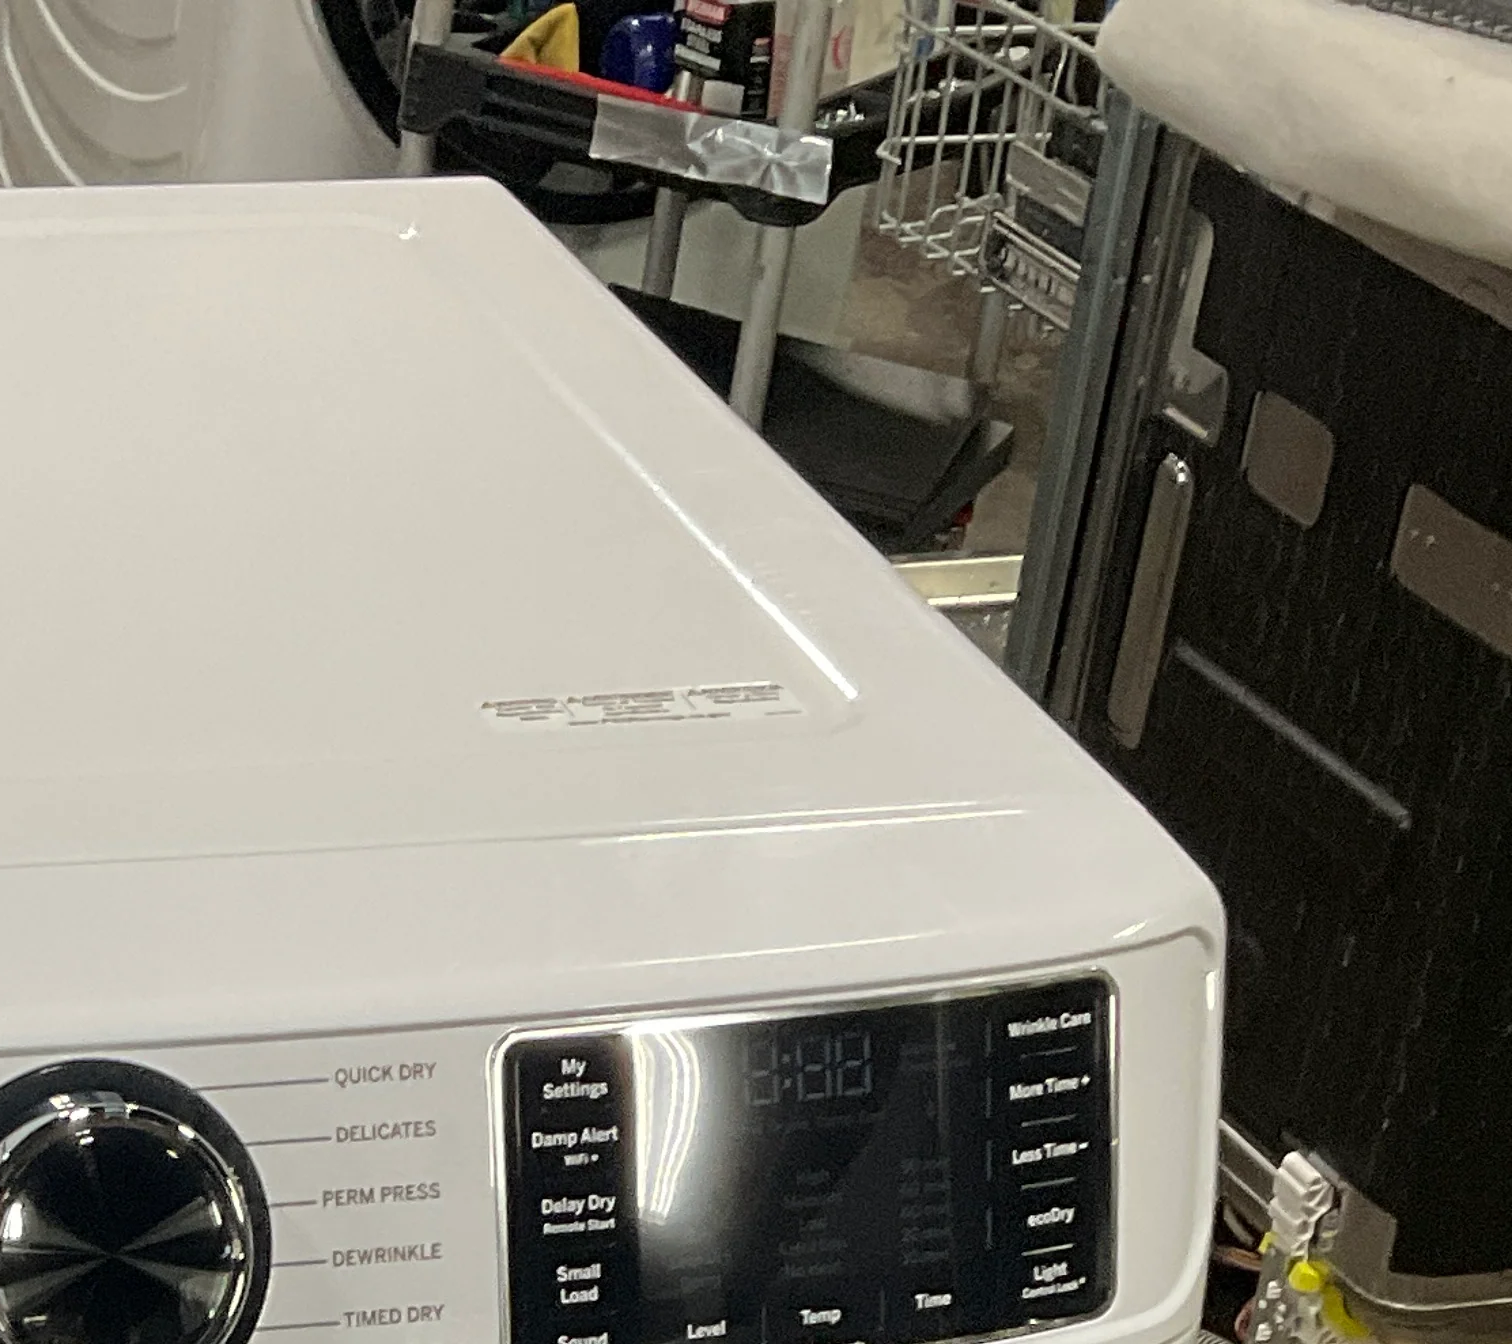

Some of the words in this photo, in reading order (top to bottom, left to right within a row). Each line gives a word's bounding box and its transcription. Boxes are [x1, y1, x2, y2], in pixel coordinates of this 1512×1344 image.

[1008, 1017, 1058, 1037] Wrinkle
[1060, 1013, 1091, 1028] Care
[335, 1066, 393, 1089] QUICK
[399, 1063, 436, 1081] DRY
[562, 1059, 586, 1077] My
[543, 1082, 608, 1099] Settings
[1010, 1084, 1043, 1100] More
[1045, 1078, 1079, 1093] Time
[336, 1120, 436, 1143] DELICATES
[532, 1132, 577, 1148] Damp
[581, 1126, 618, 1143] Alert
[1012, 1149, 1042, 1164] Less
[1043, 1142, 1077, 1158] Time
[323, 1188, 376, 1207] PERM
[380, 1183, 440, 1202] PRESS
[541, 1198, 585, 1215] Delay
[588, 1195, 616, 1212] Dry
[1028, 1207, 1074, 1226] ecoDry
[333, 1243, 441, 1267] DEWRINKLE
[556, 1264, 601, 1282] Small
[1034, 1262, 1067, 1282] Light
[560, 1286, 598, 1304] Load
[915, 1294, 951, 1308] Time
[343, 1308, 401, 1327] TIMED
[408, 1305, 444, 1323] DRY
[801, 1309, 841, 1324] Temp
[687, 1320, 726, 1339] Level
